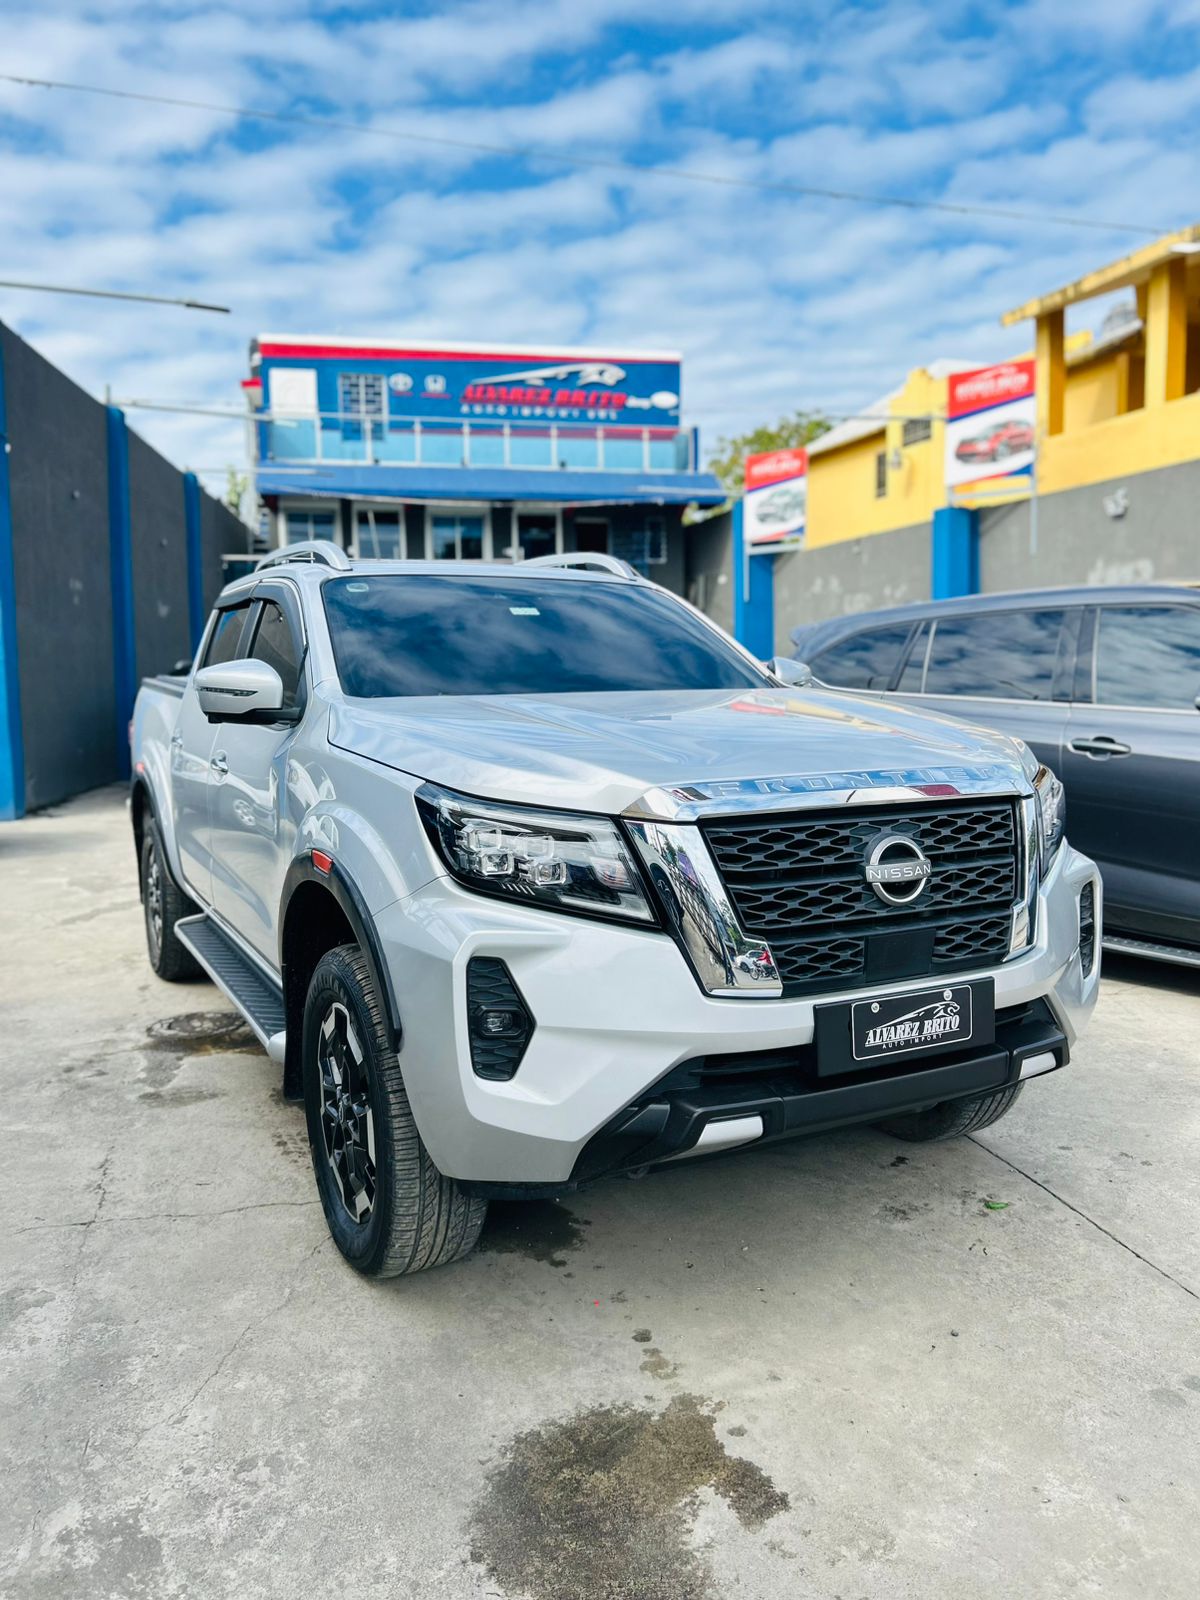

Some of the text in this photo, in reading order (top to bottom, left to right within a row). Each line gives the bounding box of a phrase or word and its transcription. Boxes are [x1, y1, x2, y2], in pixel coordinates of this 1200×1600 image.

[708, 766, 1000, 797] FRONTIER
[869, 863, 931, 879] NISSAN
[865, 1015, 960, 1045] ALVAREZ BRITO
[882, 1034, 943, 1049] AUTO IMPORT
